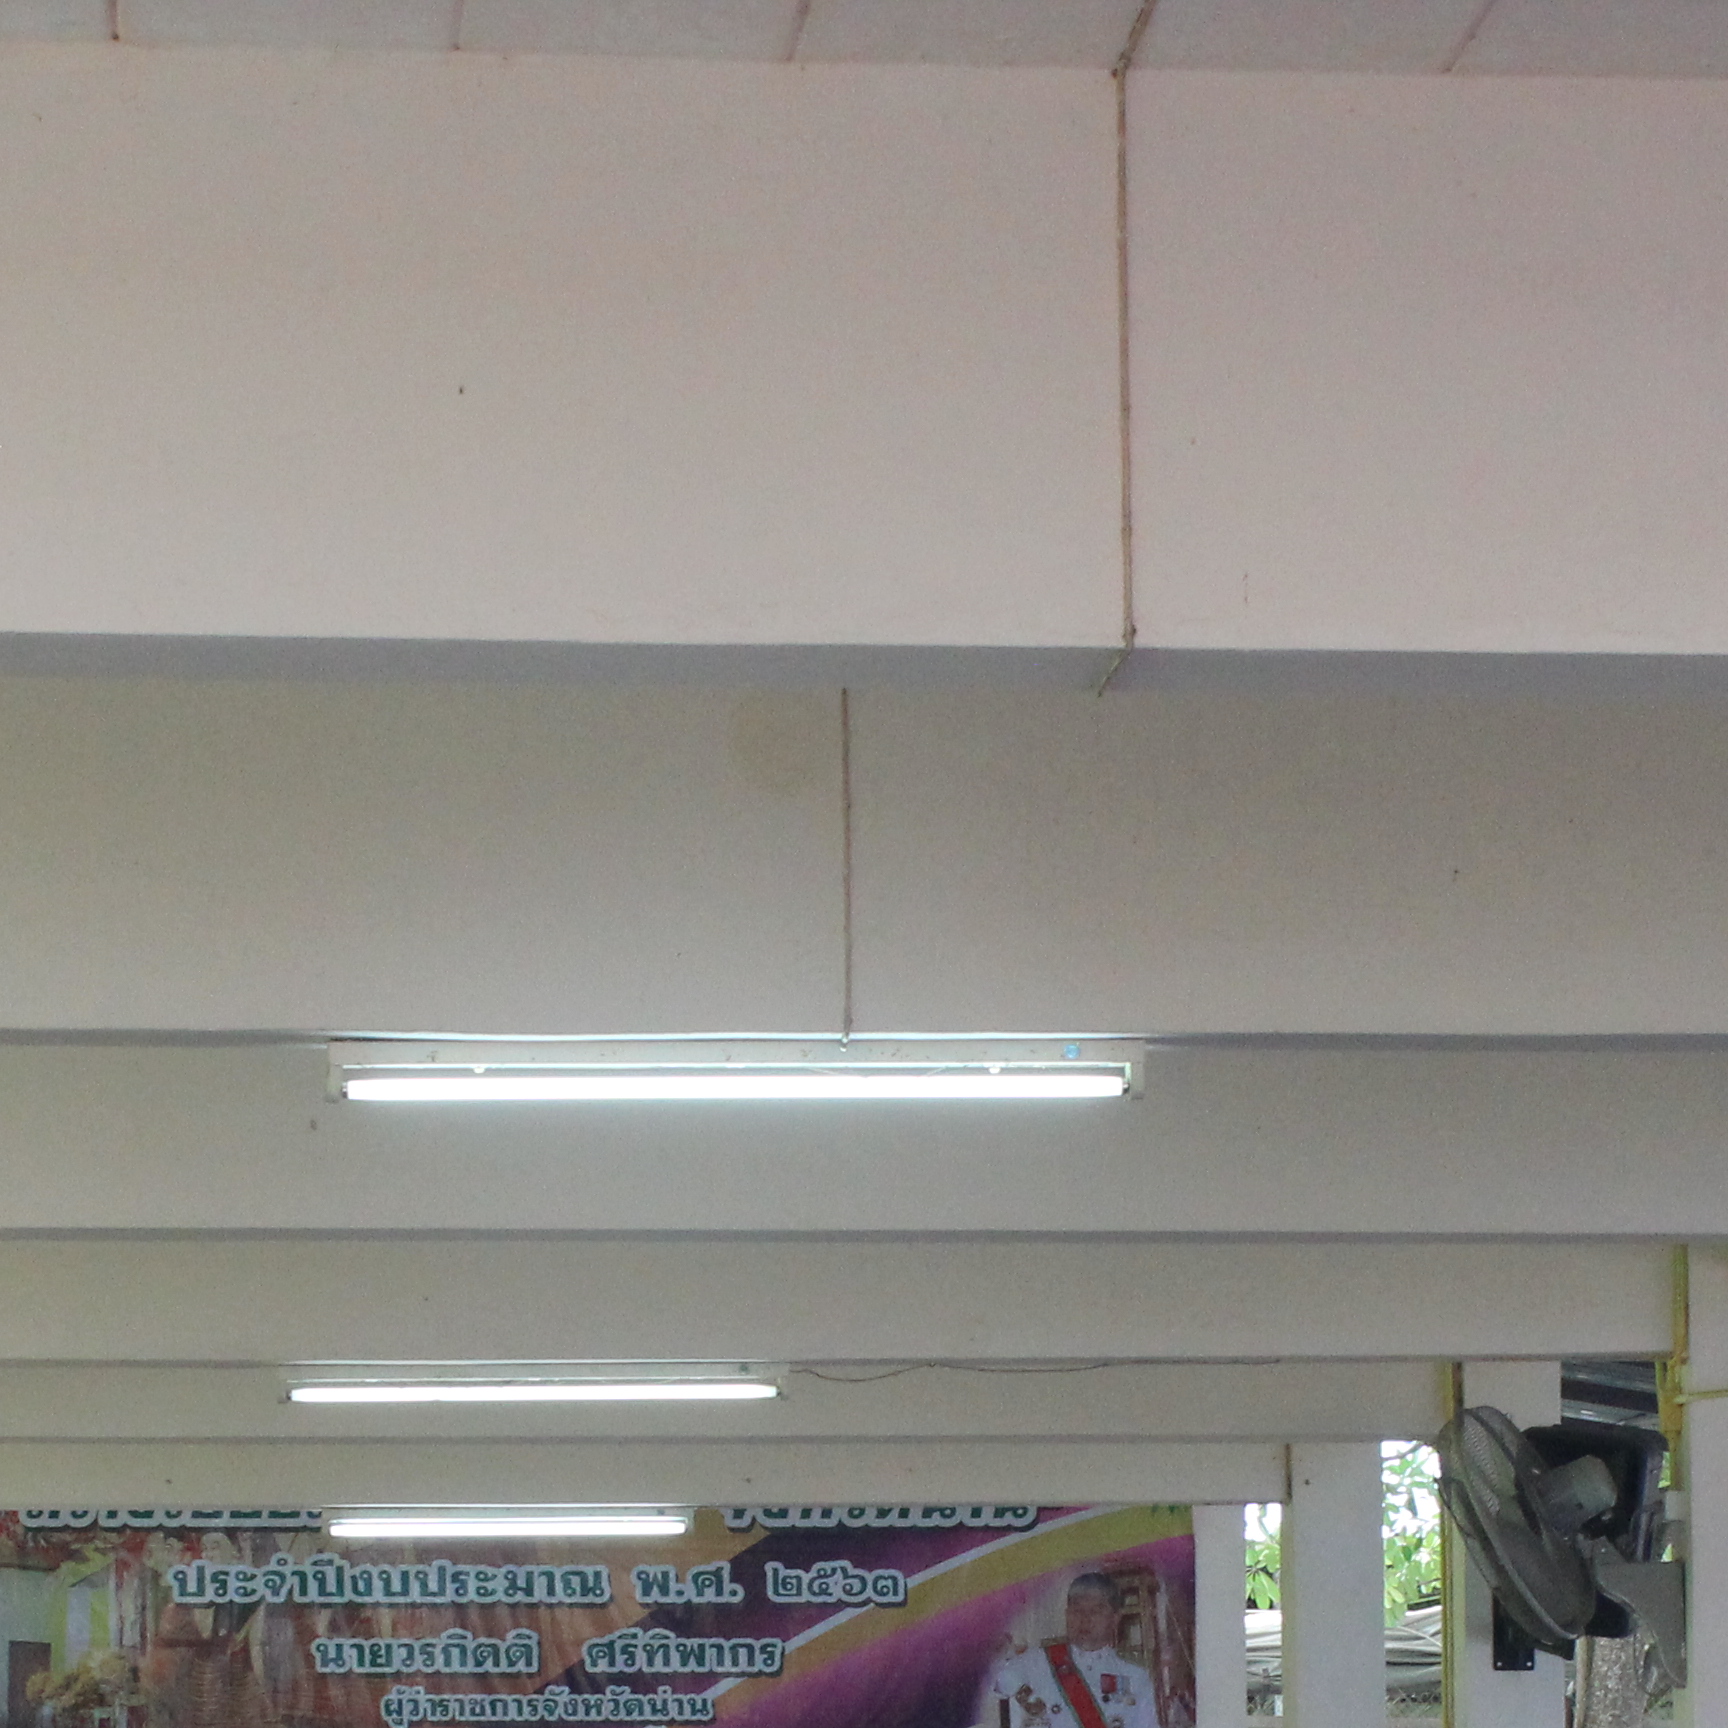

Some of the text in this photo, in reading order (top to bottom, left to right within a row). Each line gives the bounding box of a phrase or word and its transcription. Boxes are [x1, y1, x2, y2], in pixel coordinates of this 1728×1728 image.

[170, 1555, 902, 1601] ประจำปีงบประมาณ พ.ศ. ๒๕๖๓
[586, 1630, 783, 1669] ศรีทิพากร
[382, 1686, 711, 1728] ผู้ว่าราชการจังหวัดน่าน
